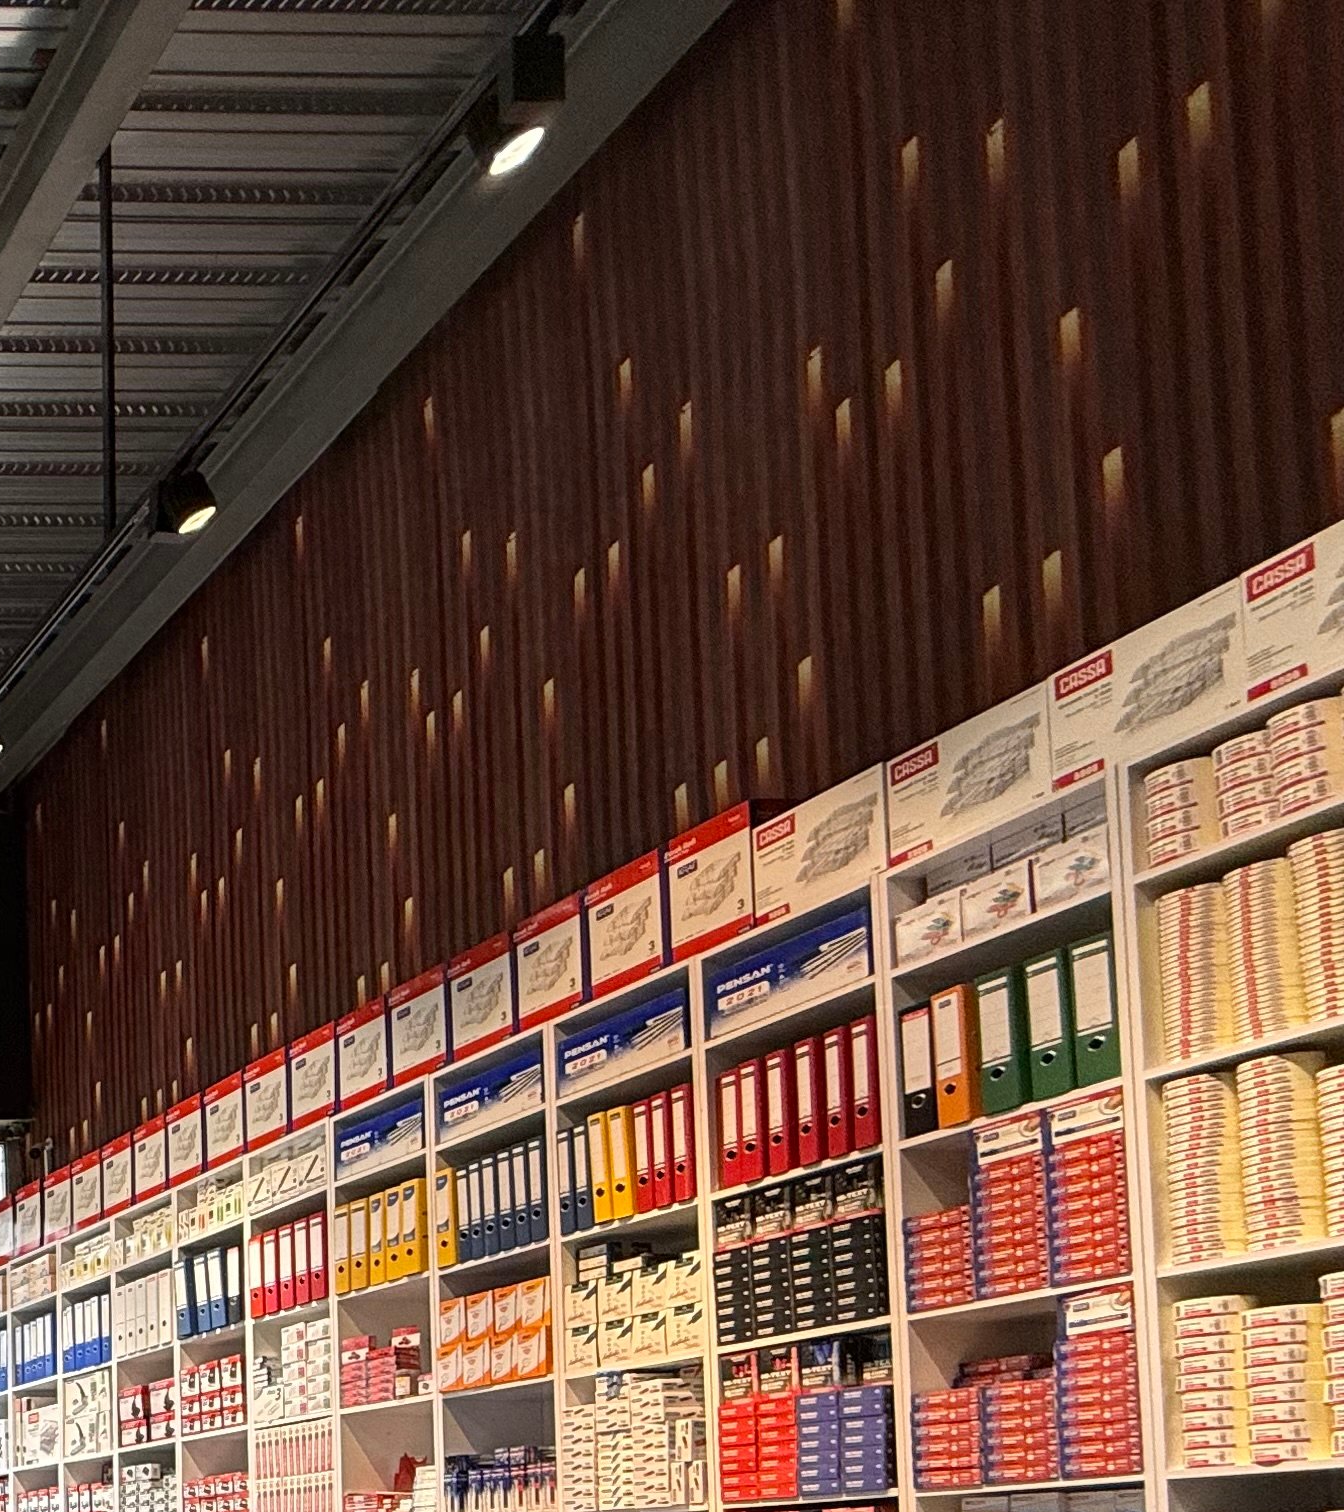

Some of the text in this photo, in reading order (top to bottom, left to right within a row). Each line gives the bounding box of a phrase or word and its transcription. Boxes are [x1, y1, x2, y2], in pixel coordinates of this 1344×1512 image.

[1252, 553, 1307, 595] CASSA
[1058, 657, 1106, 695] CASSA
[894, 749, 934, 781] CASSA
[758, 819, 791, 846] CASSA
[717, 964, 772, 994] PENSAN
[725, 985, 763, 1007] 2021
[564, 1034, 610, 1060] PENSAN
[571, 1052, 602, 1071] 2021
[444, 1087, 480, 1109] PENSAN
